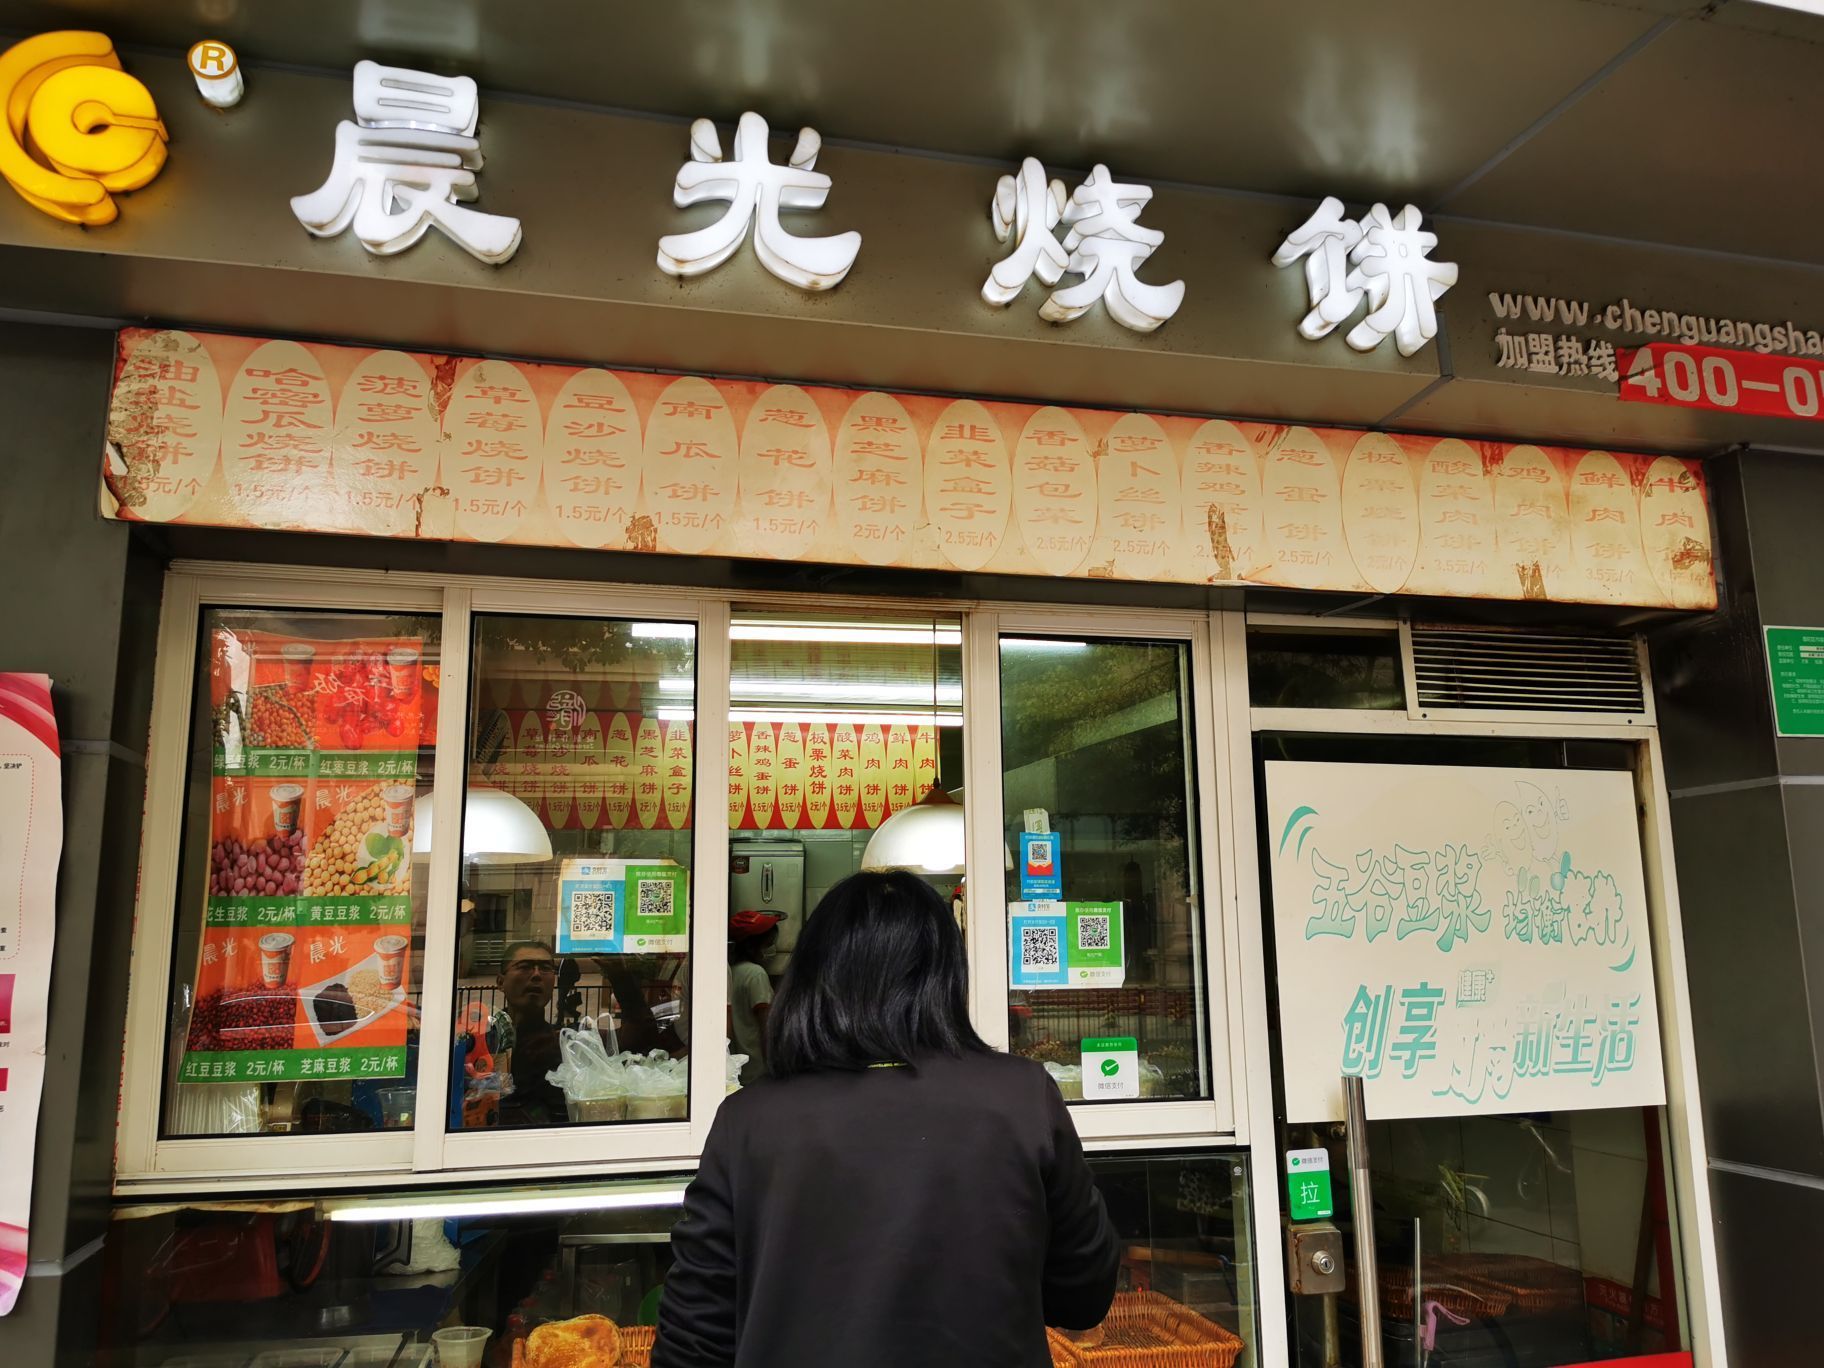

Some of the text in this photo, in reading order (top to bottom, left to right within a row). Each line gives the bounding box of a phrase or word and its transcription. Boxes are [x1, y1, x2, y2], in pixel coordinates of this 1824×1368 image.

[290, 60, 1460, 357] 晨光烧饼
[1489, 291, 1824, 355] www.chenguangsha
[1495, 328, 1824, 417] 加盟热线 400-0
[239, 368, 326, 473] 哈密瓜烧饼
[351, 375, 423, 480] 菠萝烧饼
[460, 385, 531, 487] 草莓烧饼
[560, 393, 627, 496] 豆沙烧饼
[658, 401, 724, 503] 南瓜饼
[754, 408, 817, 510] 葱花饼
[848, 415, 909, 515] 黑芝麻饼
[939, 424, 997, 520] 韭菜盒子
[1024, 430, 1084, 525] 香菇包菜
[1112, 435, 1167, 532] 萝卜丝饼
[452, 497, 528, 518] 1.5元/个
[555, 504, 629, 523] 1.5元/个
[654, 511, 726, 530] 1.5元/个
[752, 517, 819, 537] 1.5元/个
[1275, 449, 1328, 542] 葱蛋饼
[1429, 459, 1481, 552] 酸菜肉饼
[1505, 466, 1557, 557] 鸡肉饼
[1579, 471, 1631, 560] 鲜肉饼
[853, 523, 906, 541] 2元/个
[944, 531, 998, 548] 2.5元/个
[1036, 536, 1088, 553] 2.5元/个
[1113, 539, 1171, 557] 2.5元/个
[1278, 550, 1335, 567] 2.5元/个
[269, 756, 306, 771] 2元/杯
[320, 759, 413, 775] 红枣豆浆 2元/杯
[580, 728, 600, 795] 南瓜饼
[609, 729, 631, 796] 葱花饼
[639, 728, 659, 795] 黑芝麻饼
[667, 729, 688, 796] 韭菜盒子
[753, 730, 772, 795] 香辣鸡蛋饼
[781, 730, 800, 796] 葱蛋饼
[808, 731, 828, 796] 板栗烧饼
[836, 732, 855, 796] 酸菜肉饼
[863, 732, 882, 796] 鸡肉饼
[891, 732, 909, 796] 鲜肉饼
[315, 785, 354, 810] 晨光
[257, 906, 297, 922] 2元/杯
[310, 904, 407, 922] 黄豆豆浆 2元/杯
[1305, 844, 1492, 953] 五谷豆浆
[202, 937, 238, 965] 晨光
[309, 934, 348, 965] 晨光
[186, 1058, 286, 1078] 红豆豆浆 2元/杯
[301, 1055, 399, 1075] 芝麻豆浆 2元/杯
[1300, 1181, 1321, 1205] 拉
